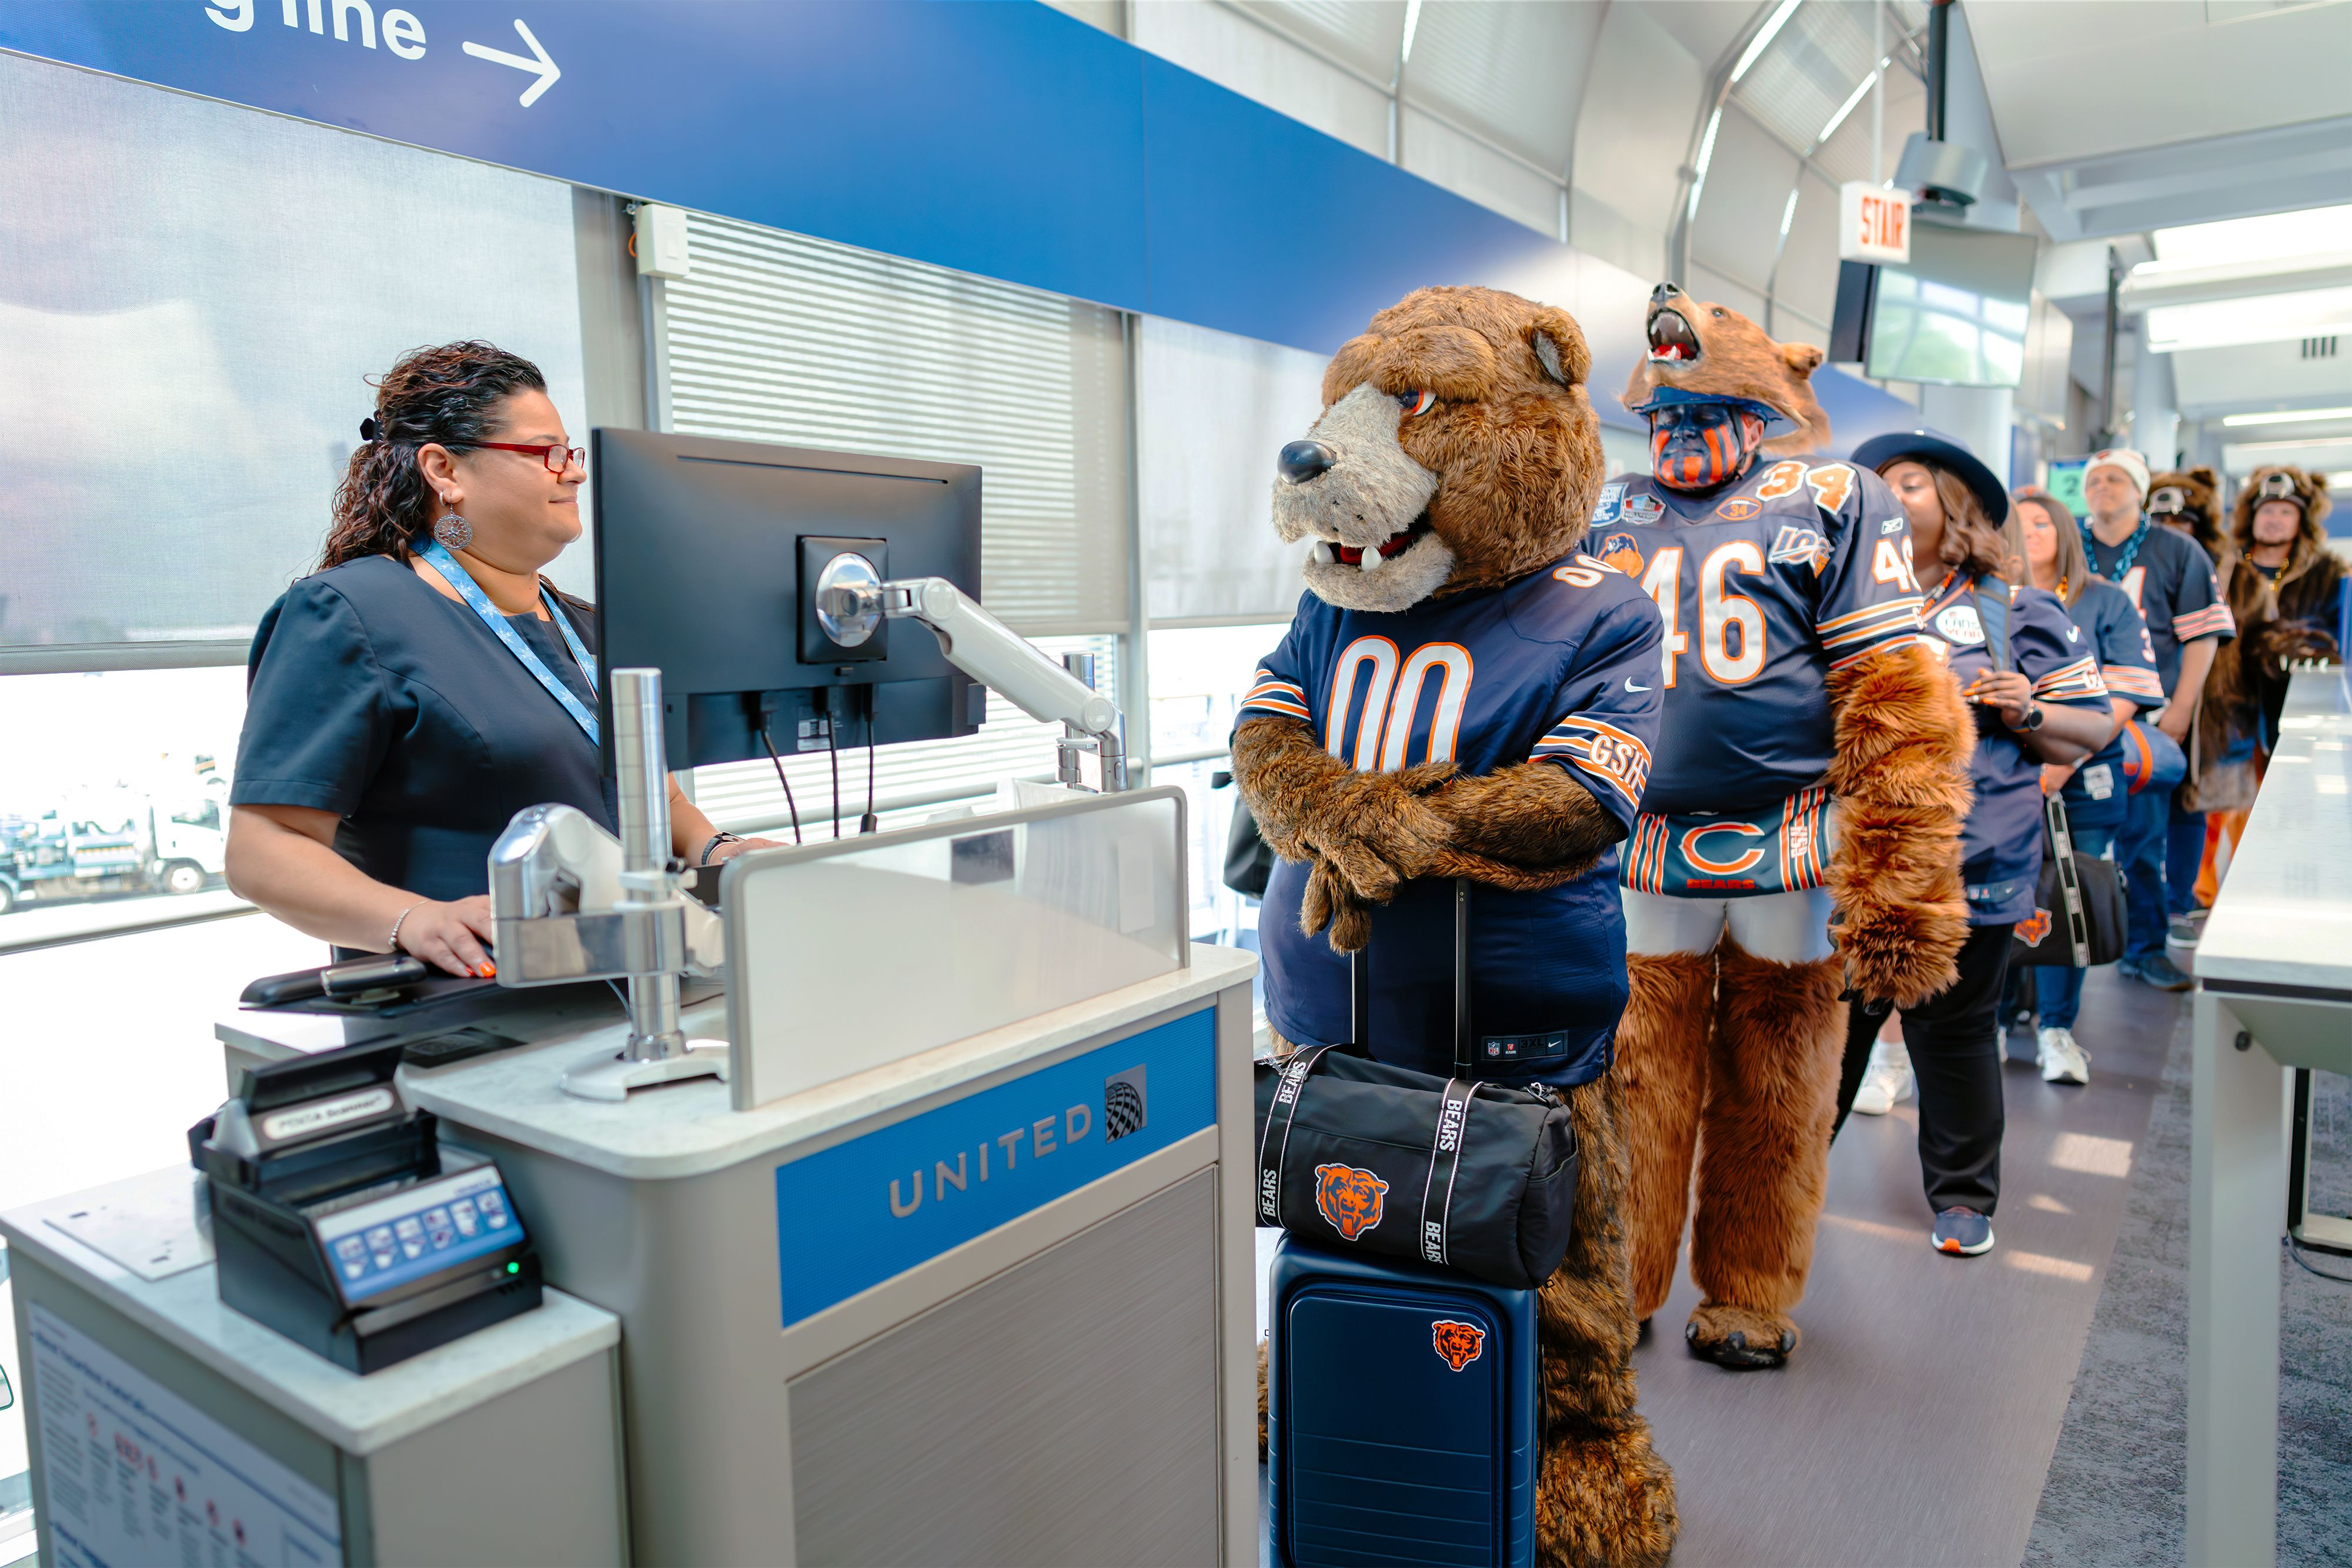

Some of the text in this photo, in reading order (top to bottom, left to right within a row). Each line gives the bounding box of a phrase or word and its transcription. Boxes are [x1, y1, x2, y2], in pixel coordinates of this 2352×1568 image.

[1861, 195, 1904, 248] STAIR
[1729, 504, 1748, 517] 34
[1755, 460, 1856, 516] 34
[1640, 539, 1767, 689] 46
[1324, 634, 1474, 771] 00
[1589, 733, 1645, 791] GSH
[1686, 878, 1756, 890] BEARS
[1521, 1038, 1545, 1049] 3XL
[1278, 1061, 1307, 1105] BEARS
[1439, 1099, 1463, 1152] BEARS
[890, 1104, 1092, 1218] UNITED
[1262, 1168, 1277, 1217] BEARS
[1425, 1221, 1443, 1264] BEARS
